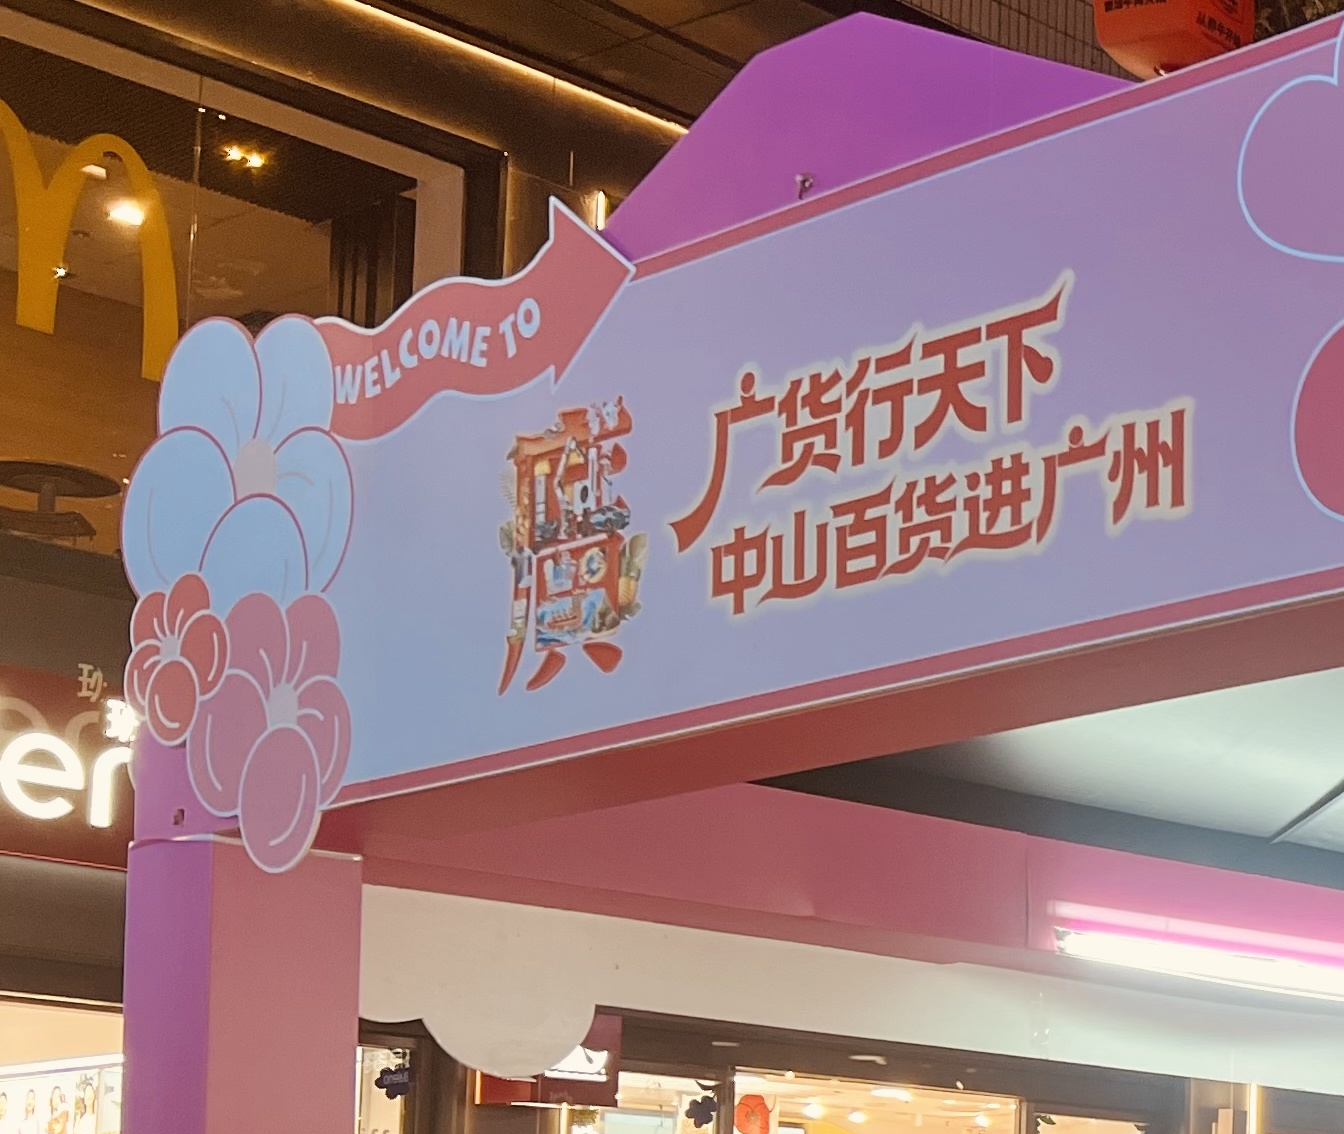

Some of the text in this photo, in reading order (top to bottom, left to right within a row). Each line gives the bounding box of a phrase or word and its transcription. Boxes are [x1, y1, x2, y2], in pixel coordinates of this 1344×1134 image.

[333, 296, 542, 405] WELCOME TO
[667, 282, 1066, 553] 广货行天下
[710, 407, 1187, 615] 中山百货进广州
